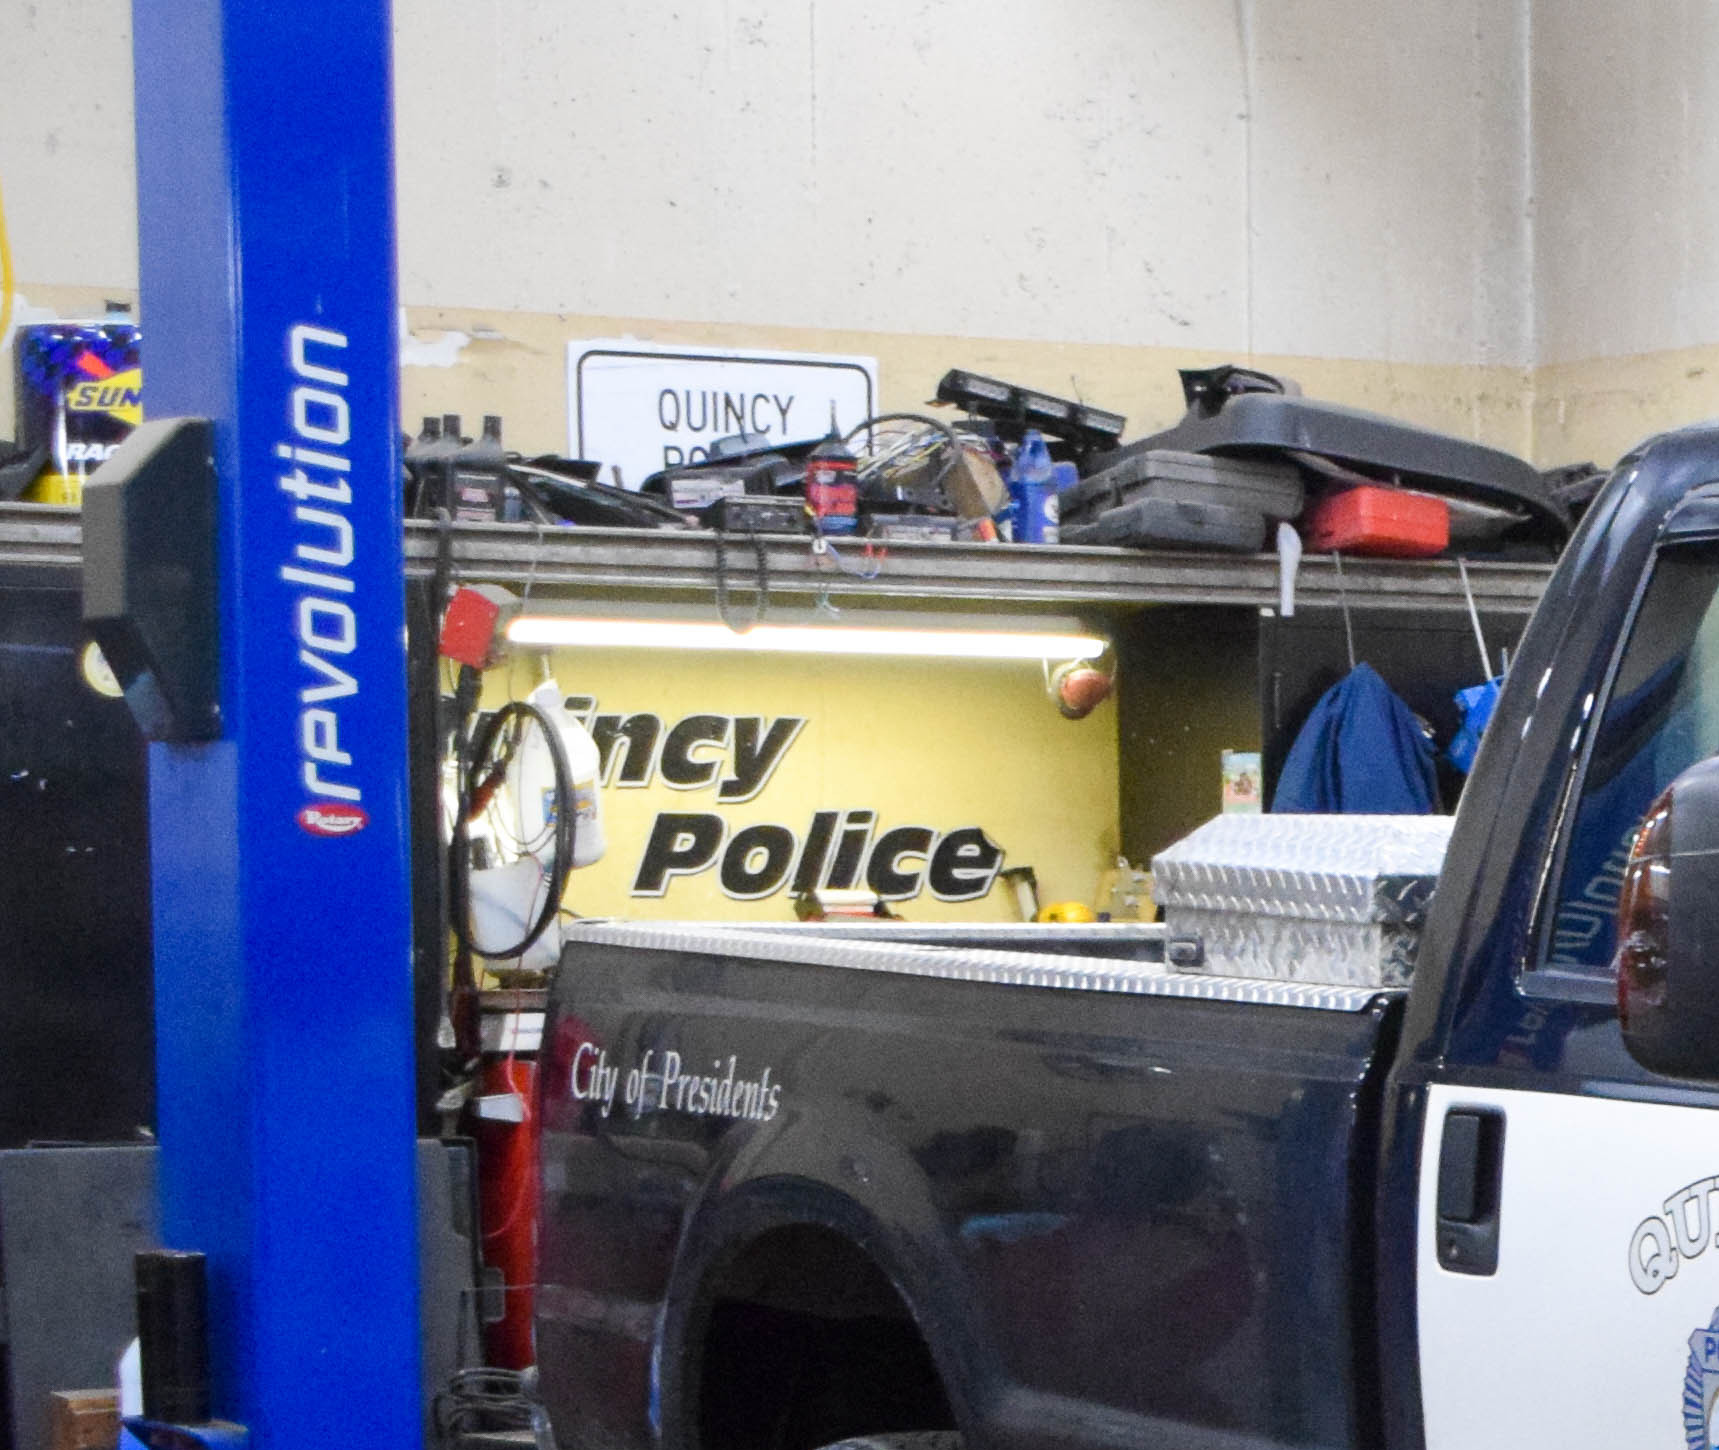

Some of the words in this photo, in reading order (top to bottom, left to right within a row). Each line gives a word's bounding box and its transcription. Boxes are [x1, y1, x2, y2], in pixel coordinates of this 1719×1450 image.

[658, 388, 795, 436] QUINCY
[629, 808, 1003, 903] Police
[571, 1041, 619, 1119] City
[623, 1049, 655, 1121] of
[657, 1051, 782, 1122] Presidents
